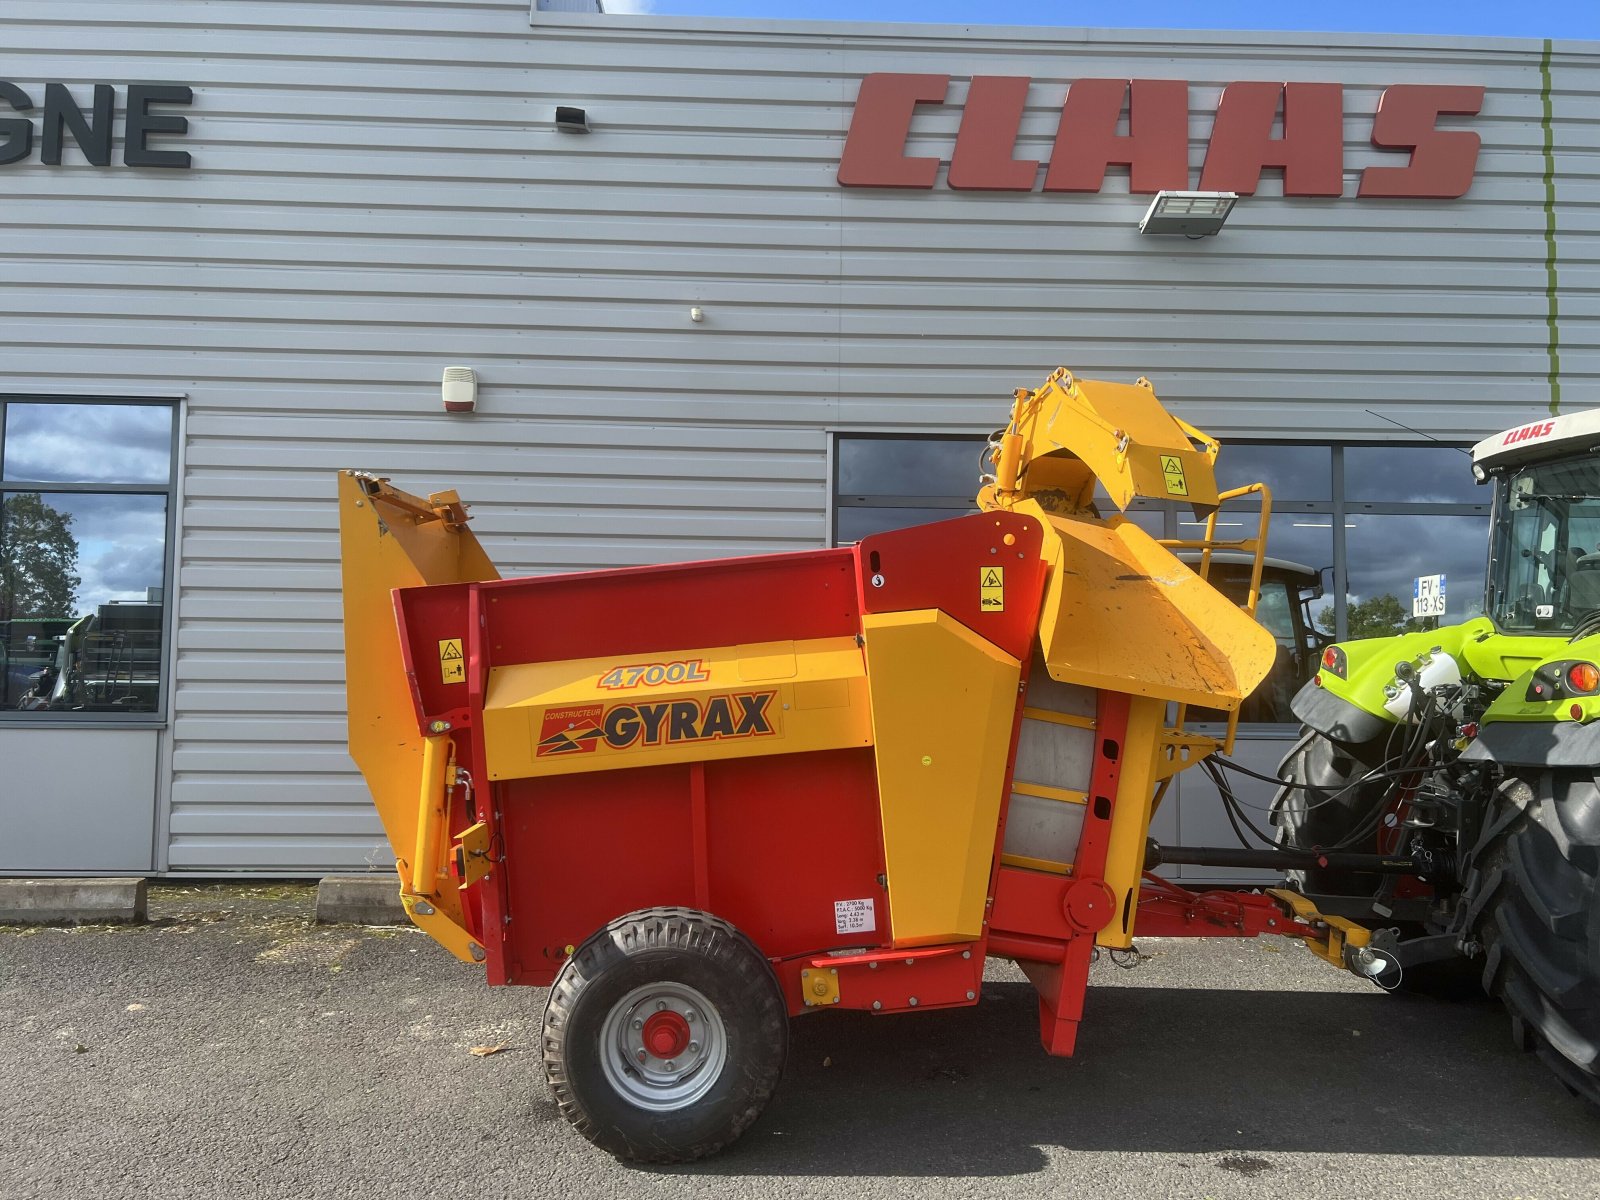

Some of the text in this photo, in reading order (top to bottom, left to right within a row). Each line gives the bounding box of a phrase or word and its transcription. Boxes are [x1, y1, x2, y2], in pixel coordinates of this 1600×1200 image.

[837, 73, 1485, 199] CLAAS
[1503, 422, 1555, 446] CLAAS
[598, 660, 709, 689] 4700L
[545, 709, 601, 720] CONSTRUCTEUR
[603, 692, 774, 747] GYRAX
